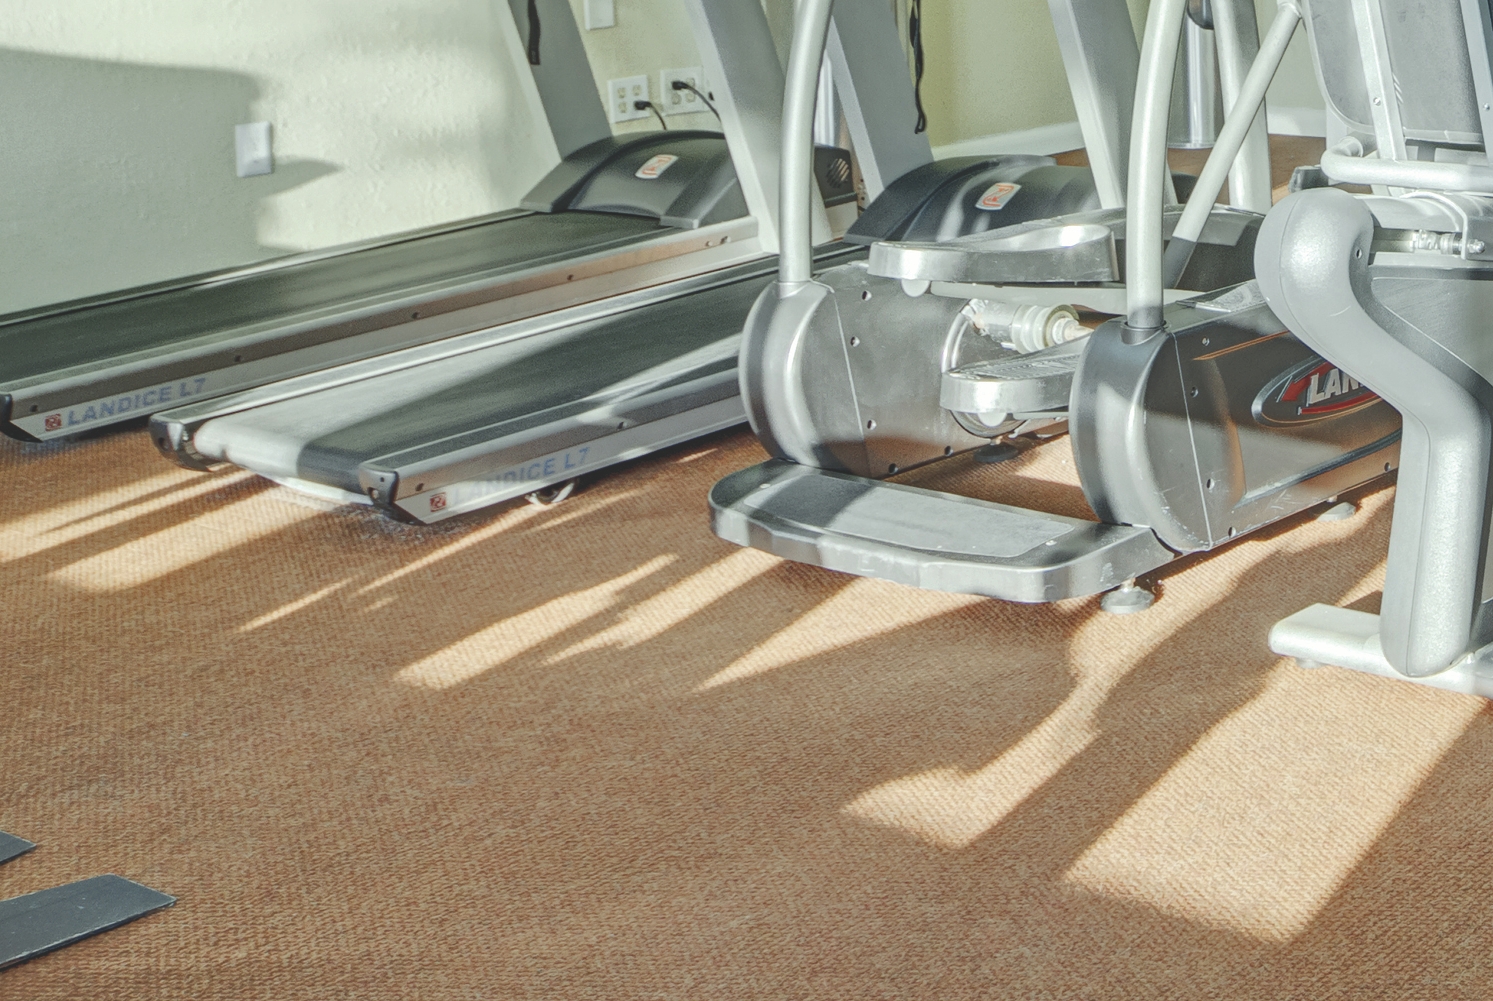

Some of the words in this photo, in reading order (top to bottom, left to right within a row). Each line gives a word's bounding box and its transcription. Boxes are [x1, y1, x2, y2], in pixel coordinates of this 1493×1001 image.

[68, 385, 172, 426] LANDICE
[180, 378, 206, 397] L7
[1309, 368, 1364, 404] LAN
[564, 447, 590, 469] L7
